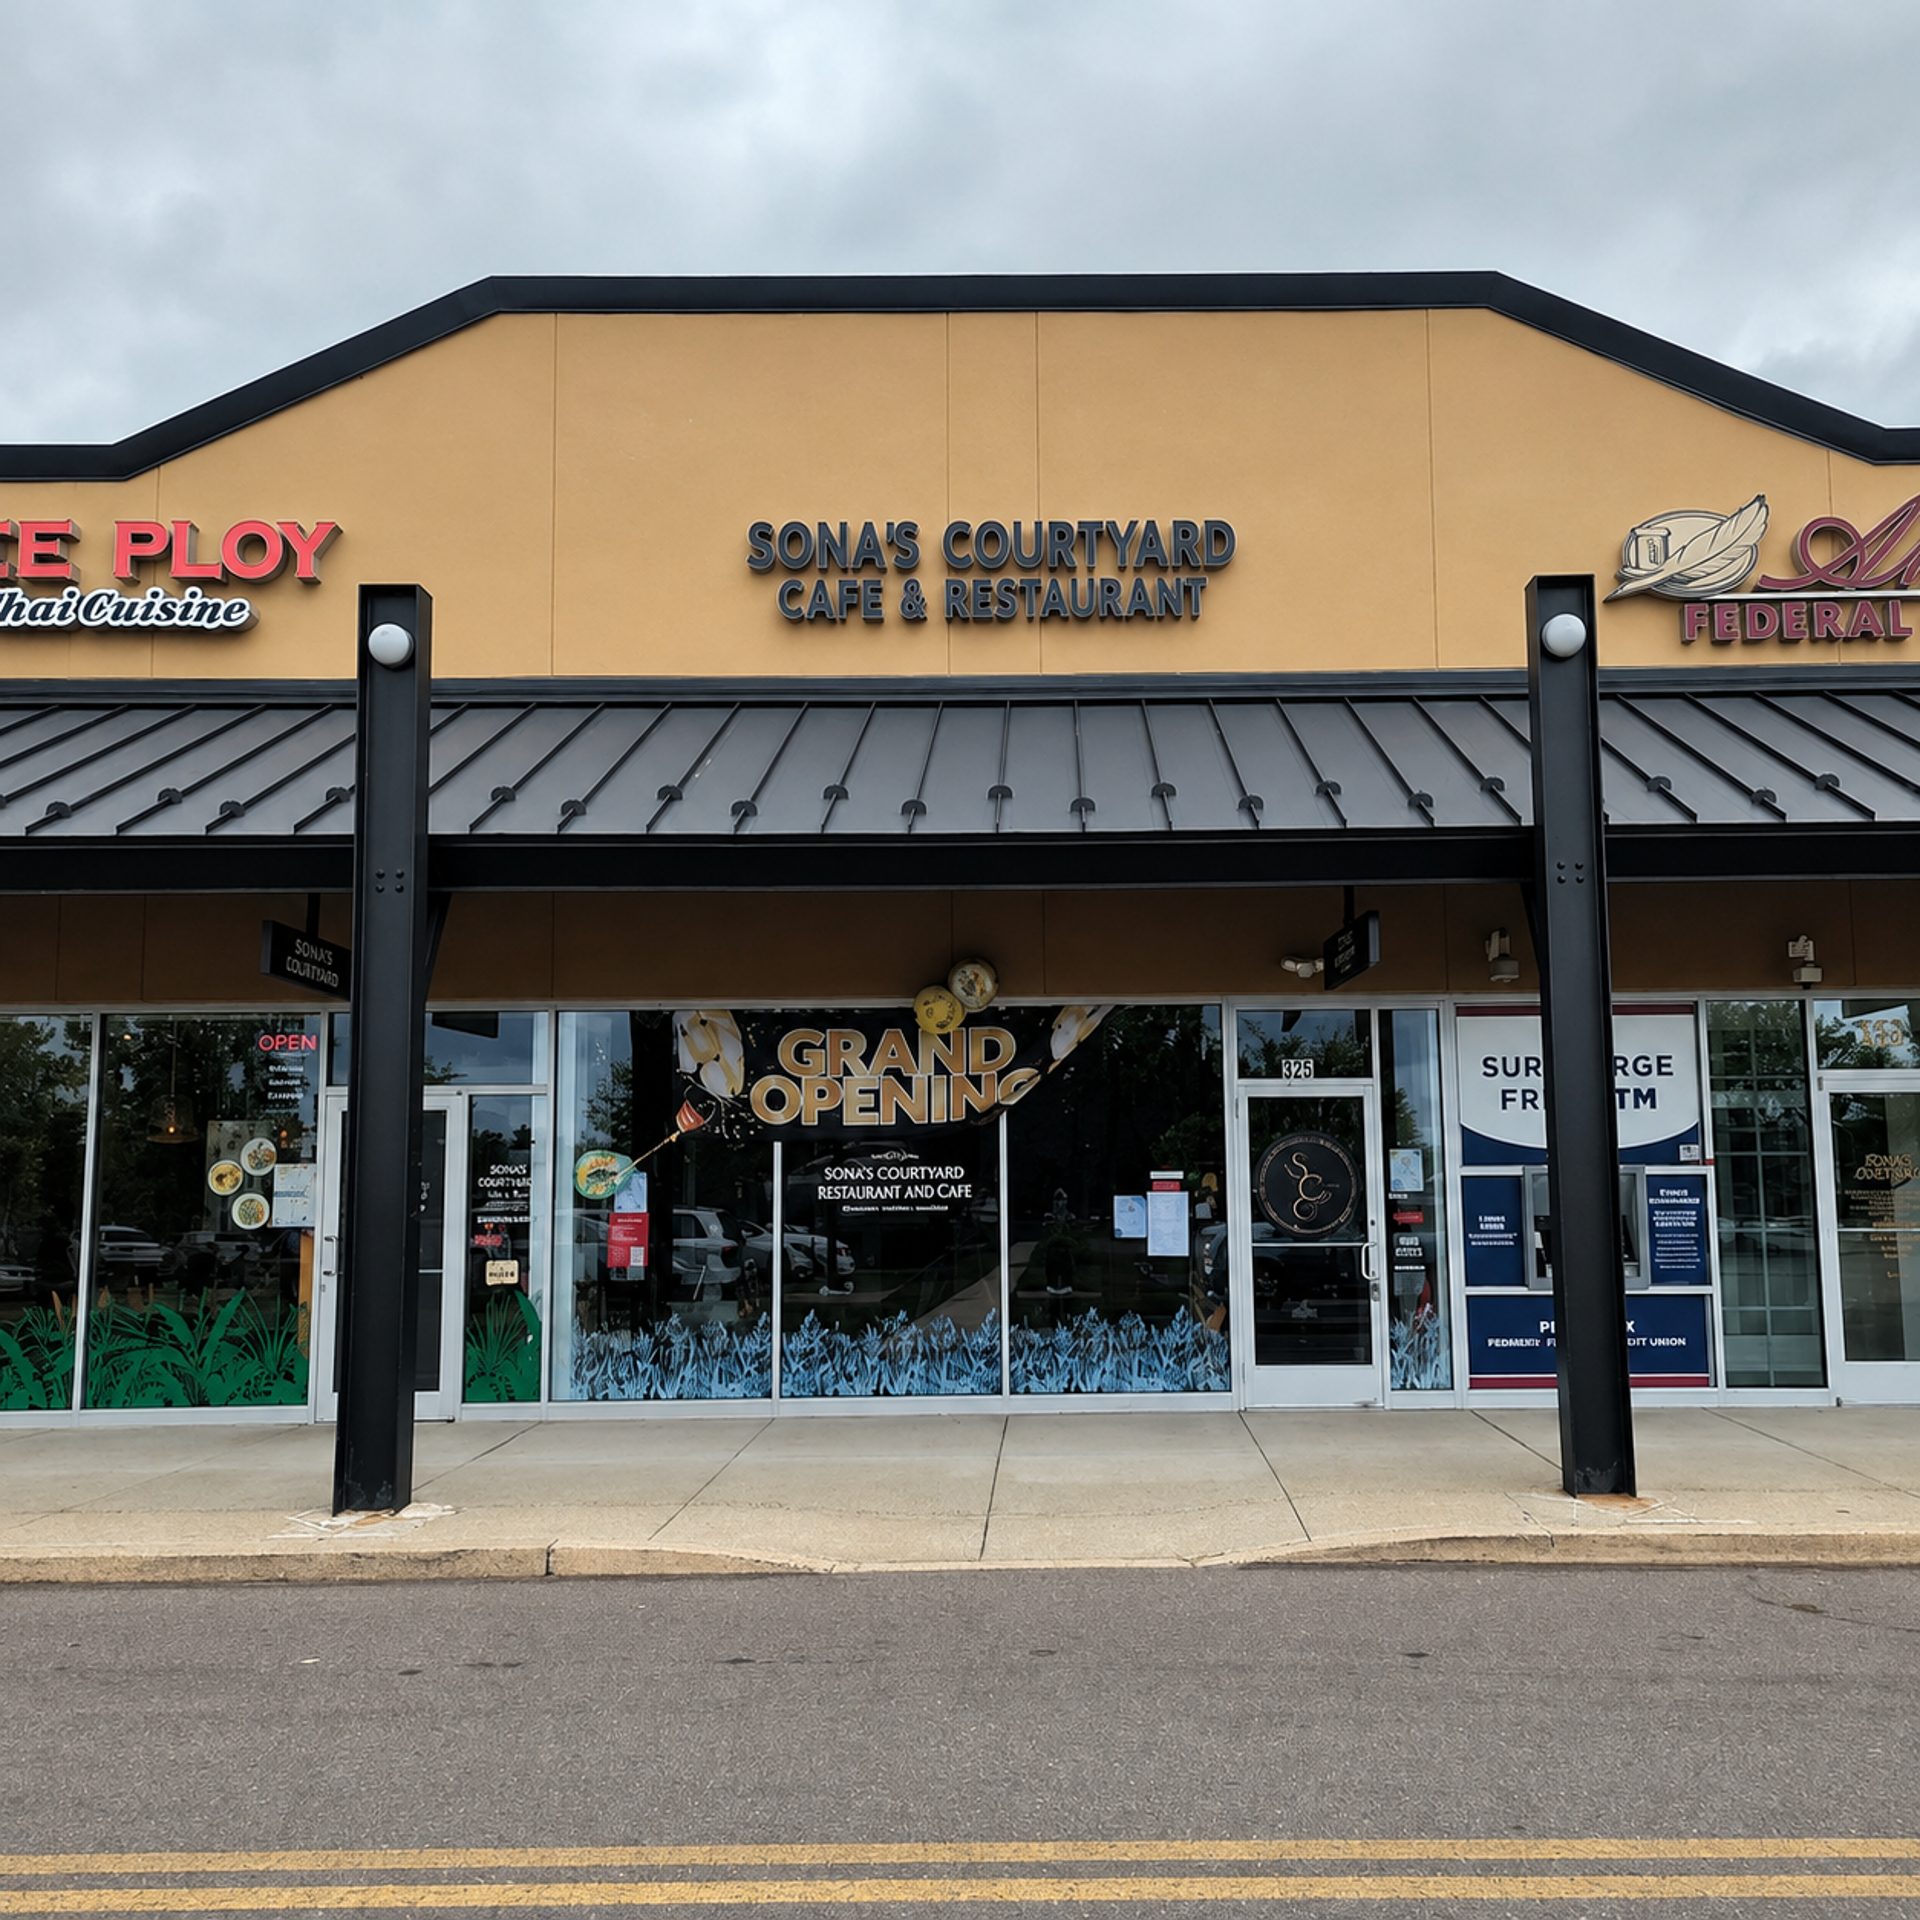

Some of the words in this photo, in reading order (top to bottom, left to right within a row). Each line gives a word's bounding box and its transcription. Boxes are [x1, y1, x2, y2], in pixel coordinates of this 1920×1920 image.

[0, 519, 80, 584] E
[113, 519, 343, 584] PLOY
[747, 520, 922, 572] SONA'S
[942, 519, 1237, 571] COURTYARD
[0, 587, 80, 627] hai
[78, 586, 252, 628] Cuisine
[776, 578, 886, 621] CAFE
[899, 578, 928, 621] &
[944, 577, 1209, 620] RESTAURANT
[1682, 600, 1913, 644] FEDERAL
[258, 1034, 317, 1052] OPEN
[777, 1027, 1017, 1078] GRAND
[1283, 1060, 1313, 1080] 325
[818, 1185, 901, 1200] RESTAURANT
[904, 1185, 934, 1199] AND
[824, 1166, 874, 1181] SONA'S
[877, 1166, 965, 1181] COURTYARD
[1649, 1337, 1687, 1347] UNION
